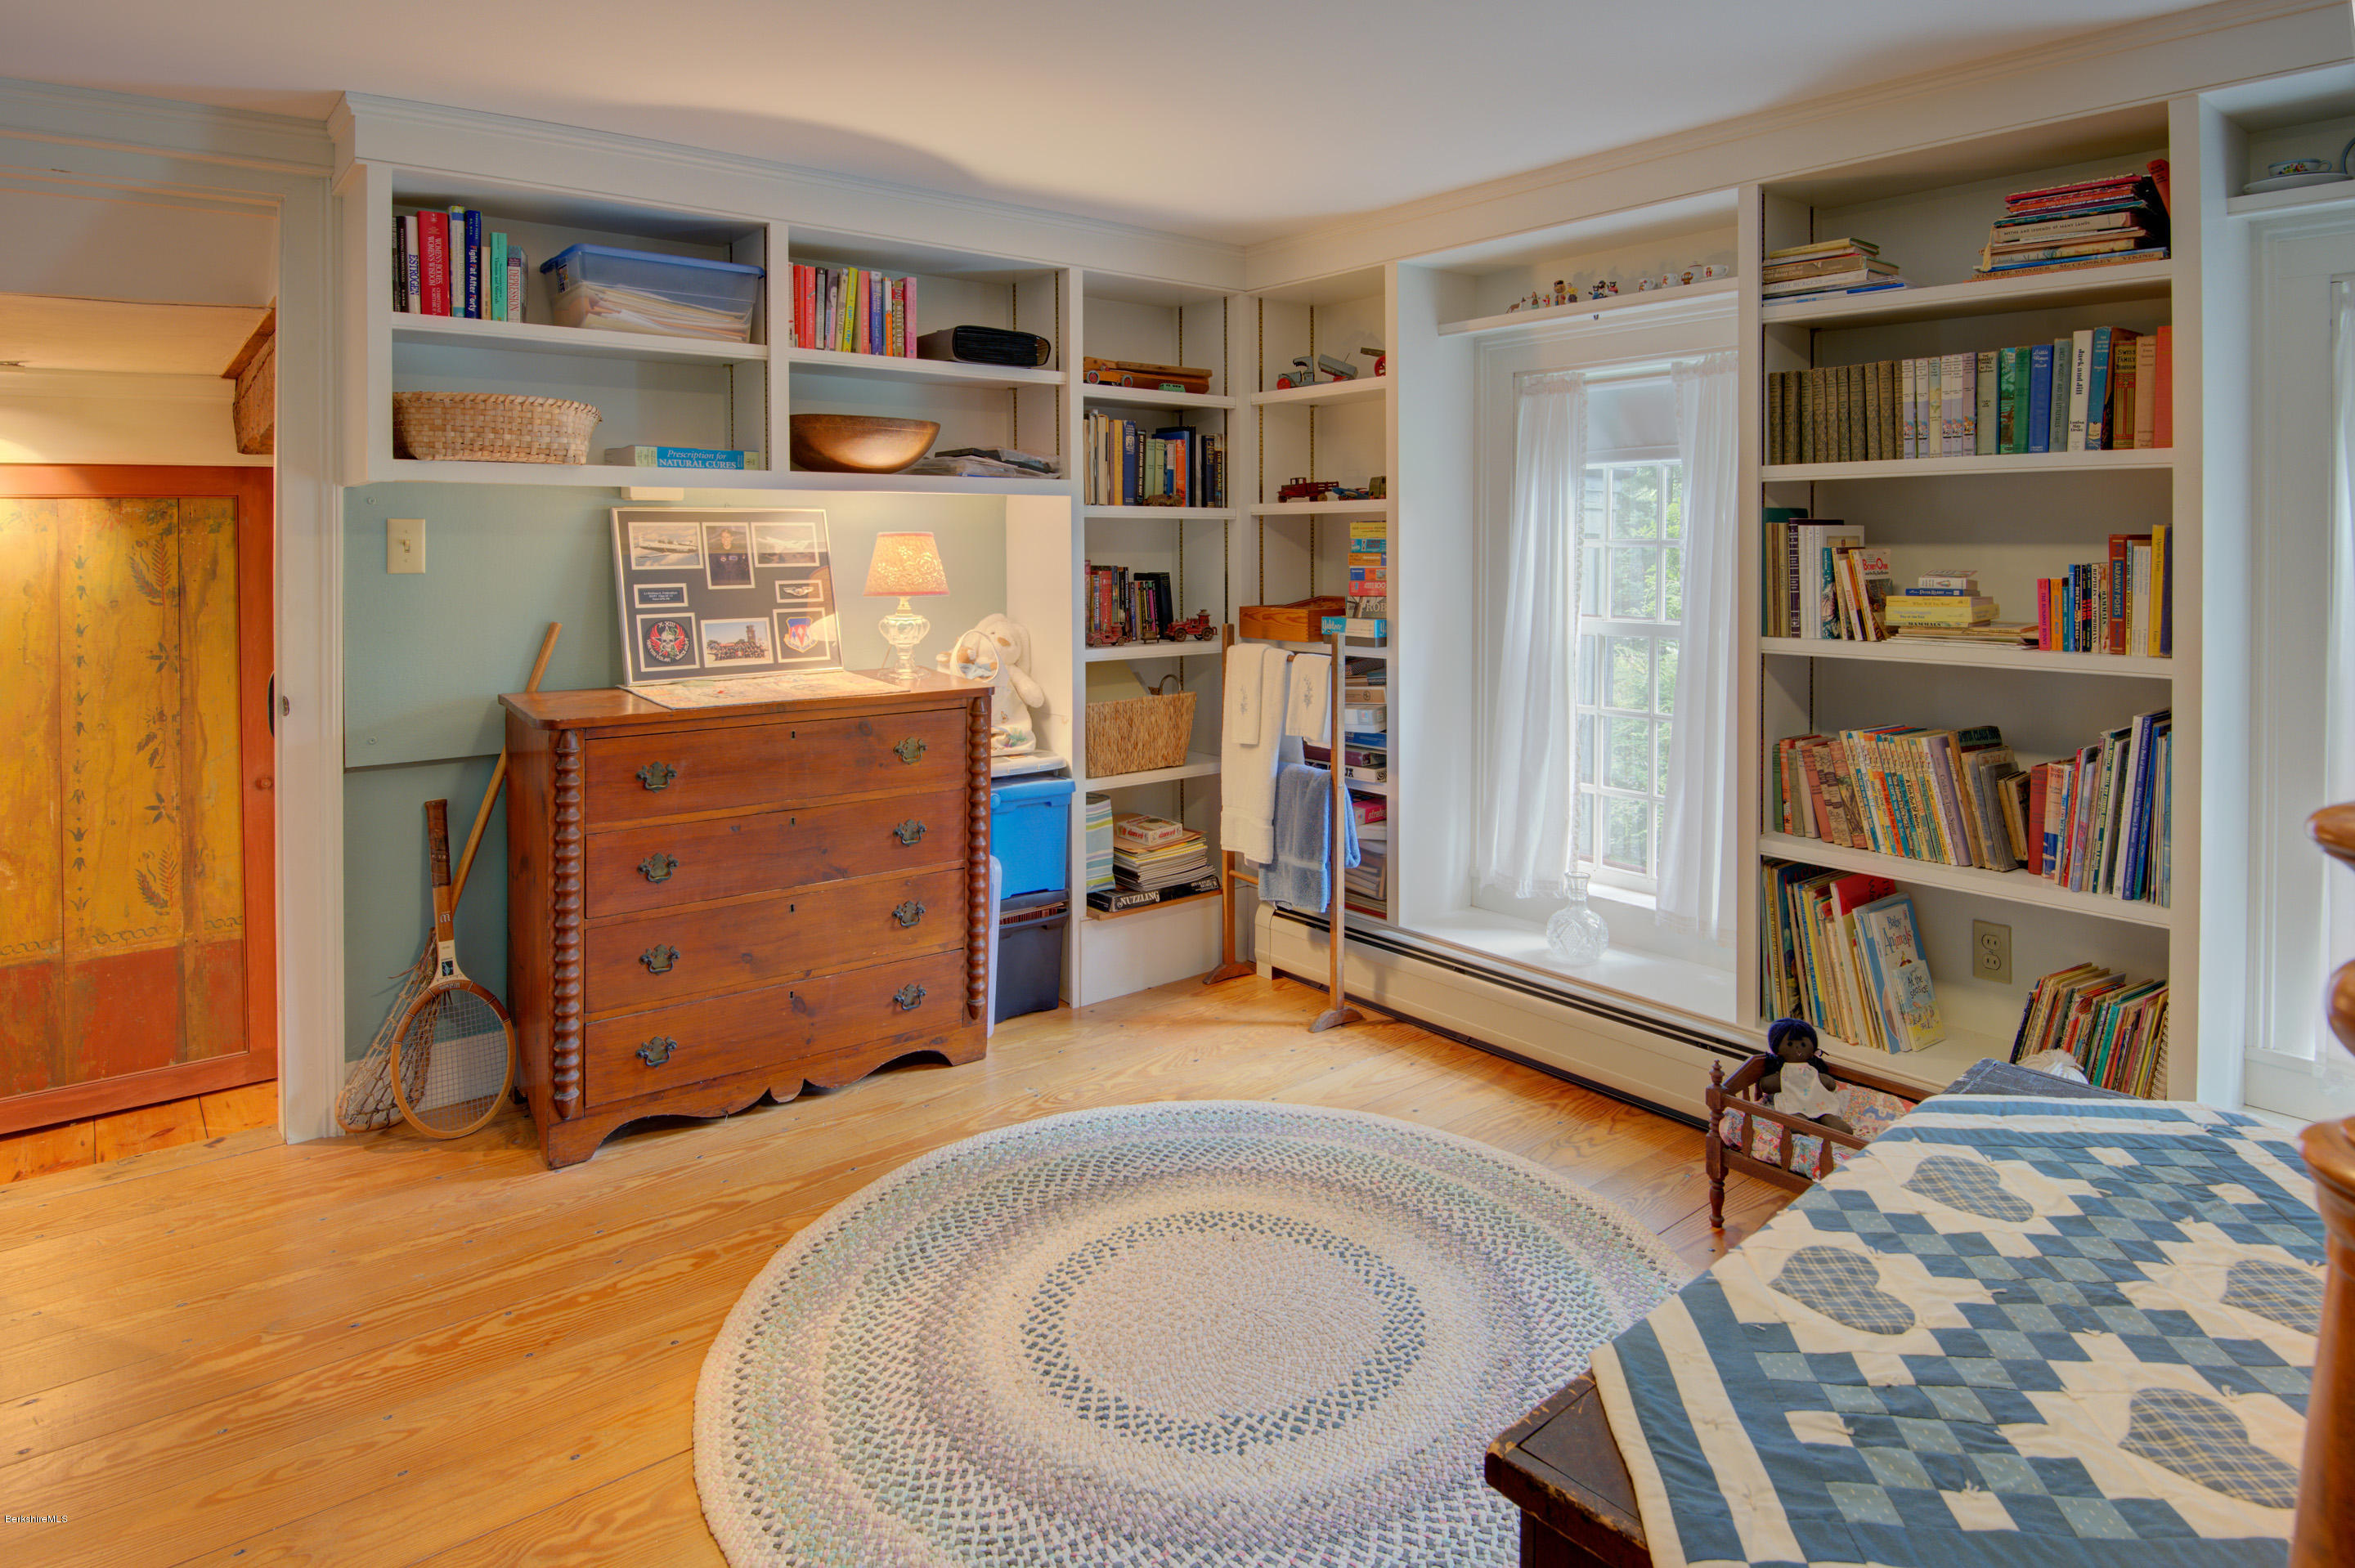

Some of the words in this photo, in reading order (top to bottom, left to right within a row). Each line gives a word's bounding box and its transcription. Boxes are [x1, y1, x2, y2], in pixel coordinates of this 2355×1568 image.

[2017, 266, 2051, 275] WONDER
[2123, 253, 2155, 262] VIKING
[409, 254, 419, 296] ESTROGEN
[509, 269, 519, 312] DEPRESSION
[2077, 348, 2085, 366] Jack
[2075, 383, 2084, 395] Jill
[667, 450, 715, 459] Prescription
[715, 451, 726, 460] for
[659, 458, 703, 468] NATURAL
[706, 461, 736, 469] CURES
[1913, 813, 1921, 828] Water
[1887, 916, 1900, 930] Baby
[1882, 926, 1912, 956] Animals
[1907, 977, 1915, 988] At
